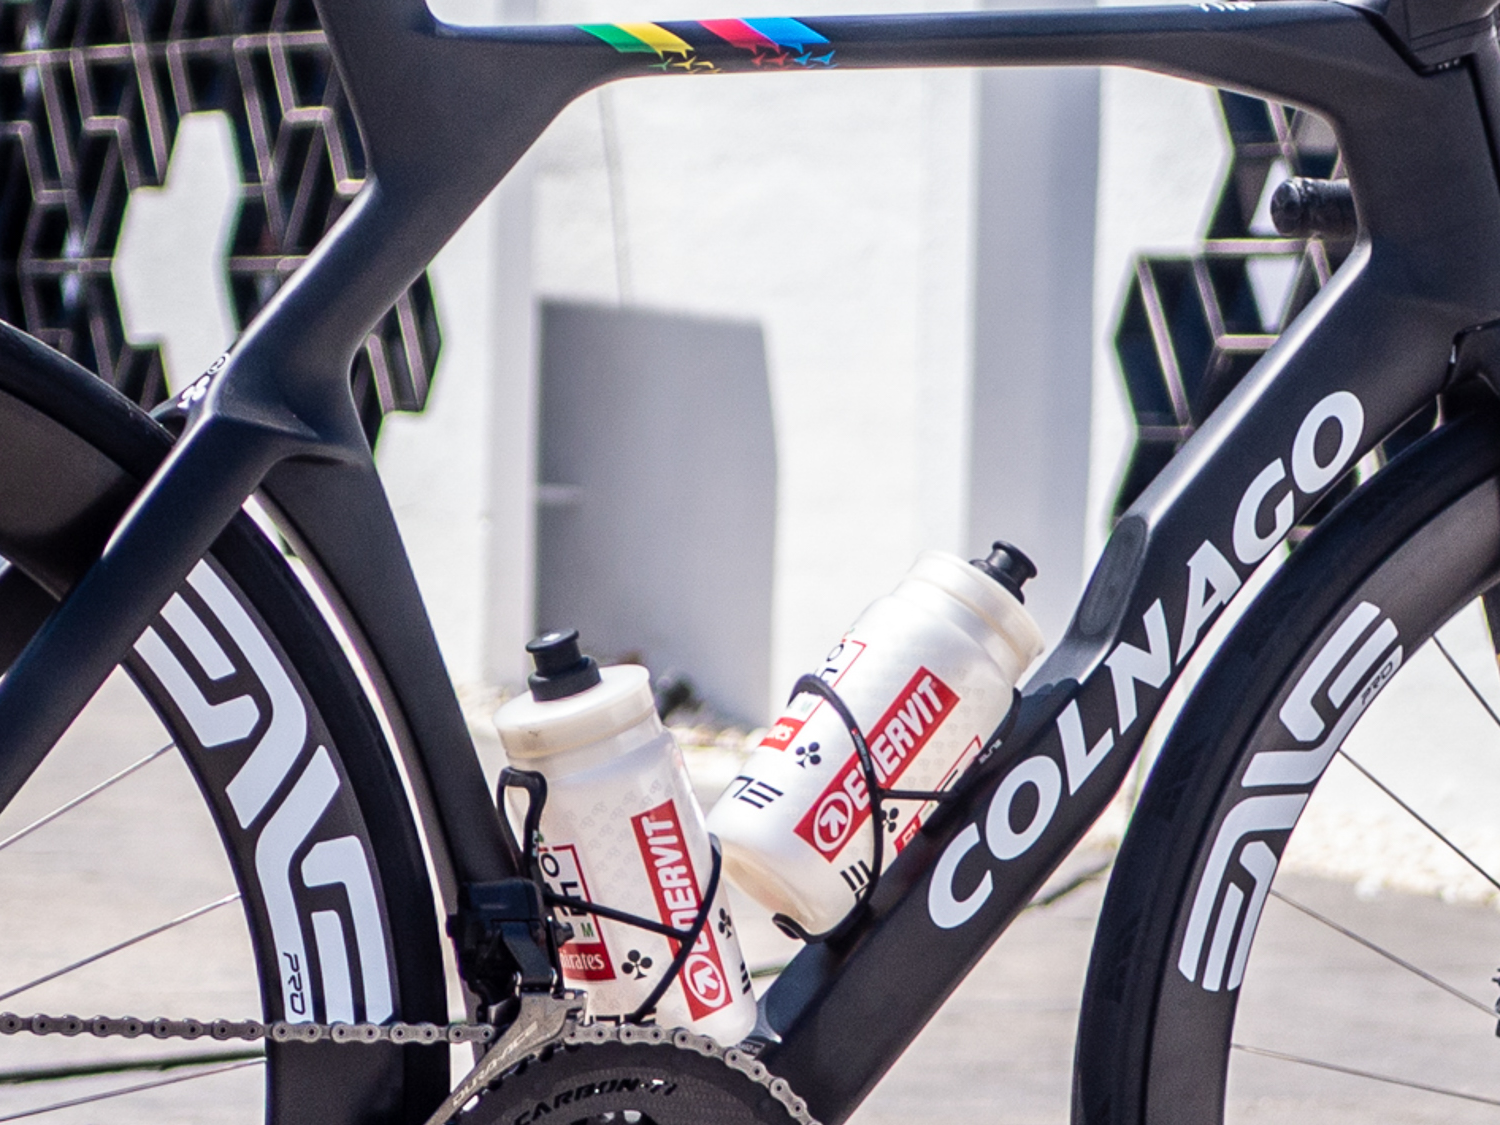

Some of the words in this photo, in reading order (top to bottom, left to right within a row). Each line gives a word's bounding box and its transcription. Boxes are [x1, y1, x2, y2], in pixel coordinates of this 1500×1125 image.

[927, 390, 1364, 928] COLNAGO
[1361, 661, 1393, 706] PRO
[282, 951, 306, 1016] PRO
